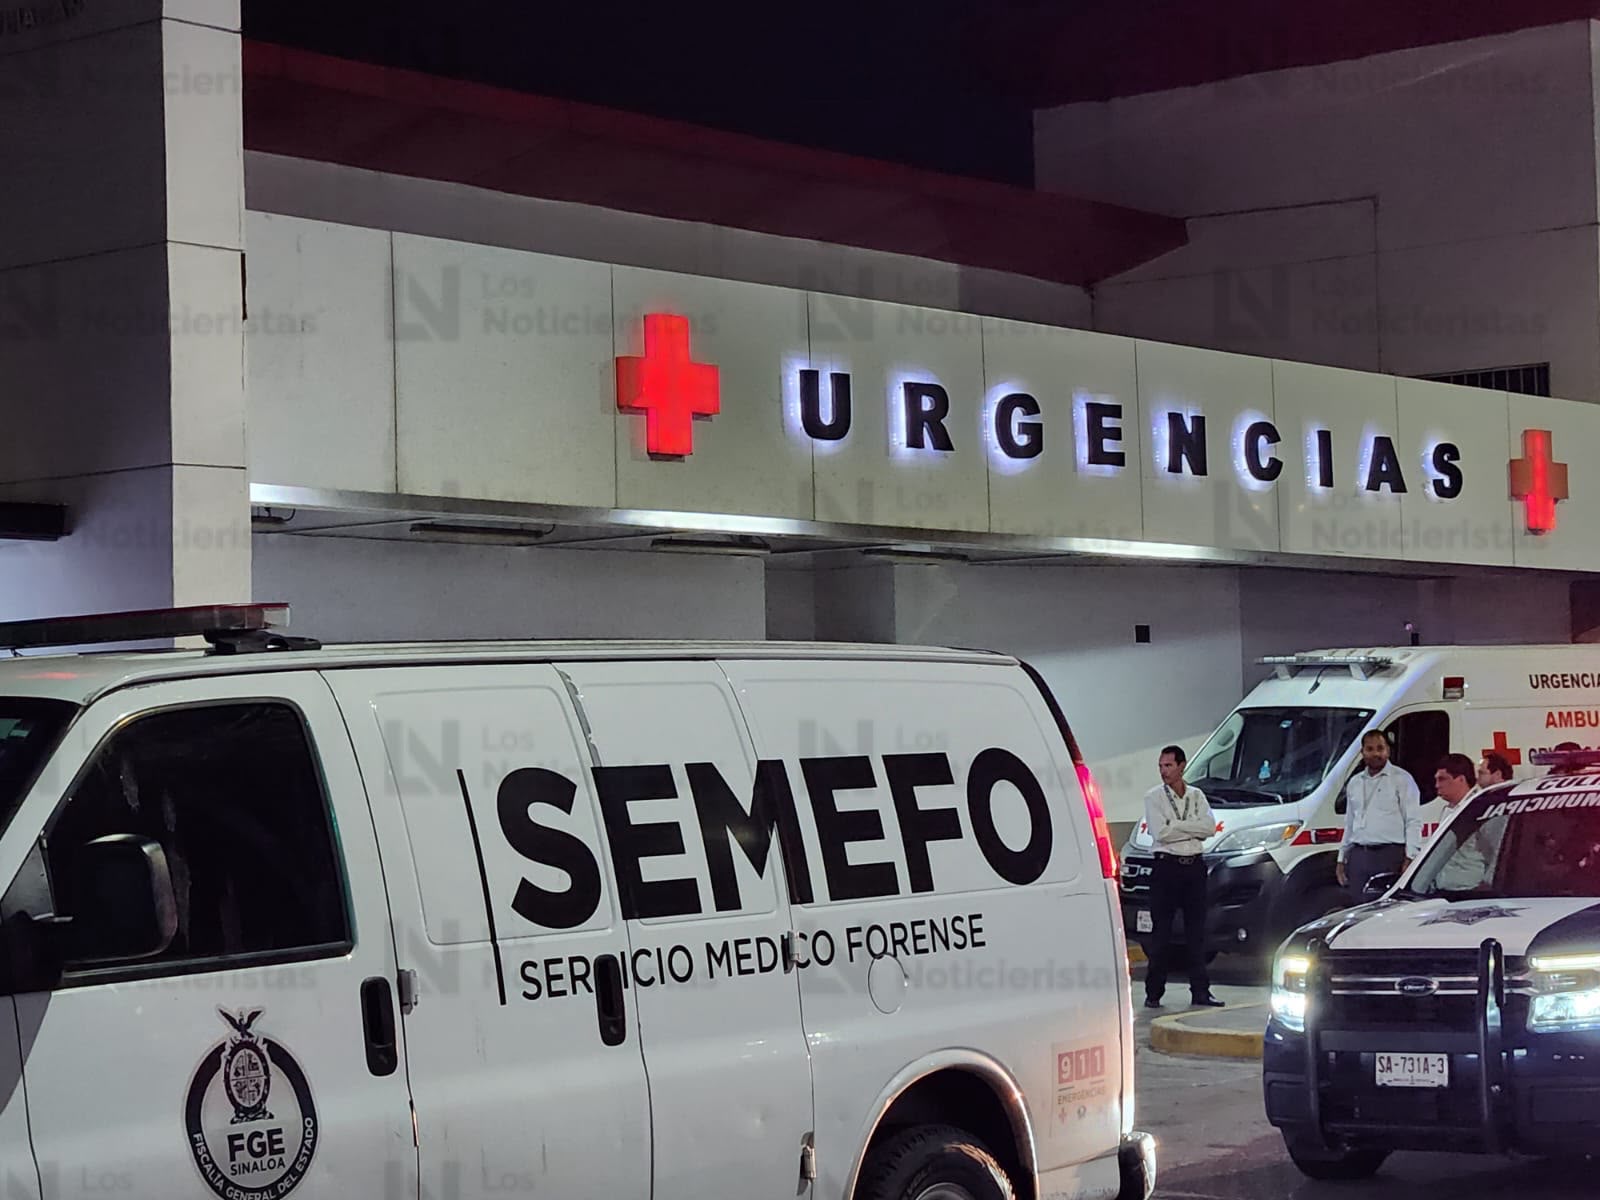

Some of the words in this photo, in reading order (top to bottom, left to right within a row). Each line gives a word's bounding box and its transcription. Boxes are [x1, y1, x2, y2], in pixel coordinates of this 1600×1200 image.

[799, 369, 1464, 499] URGENCIAS
[497, 747, 1053, 930] SEMEFO
[520, 945, 694, 1001] SERICIO
[845, 913, 987, 964] FORENSE
[1060, 1048, 1102, 1081] 911
[1378, 1056, 1444, 1074] SA-731A-3
[226, 1128, 286, 1162] FGE
[230, 1159, 286, 1176] SINALOA
[276, 1173, 298, 1194] DEL
[295, 1117, 314, 1173] ESTADO
